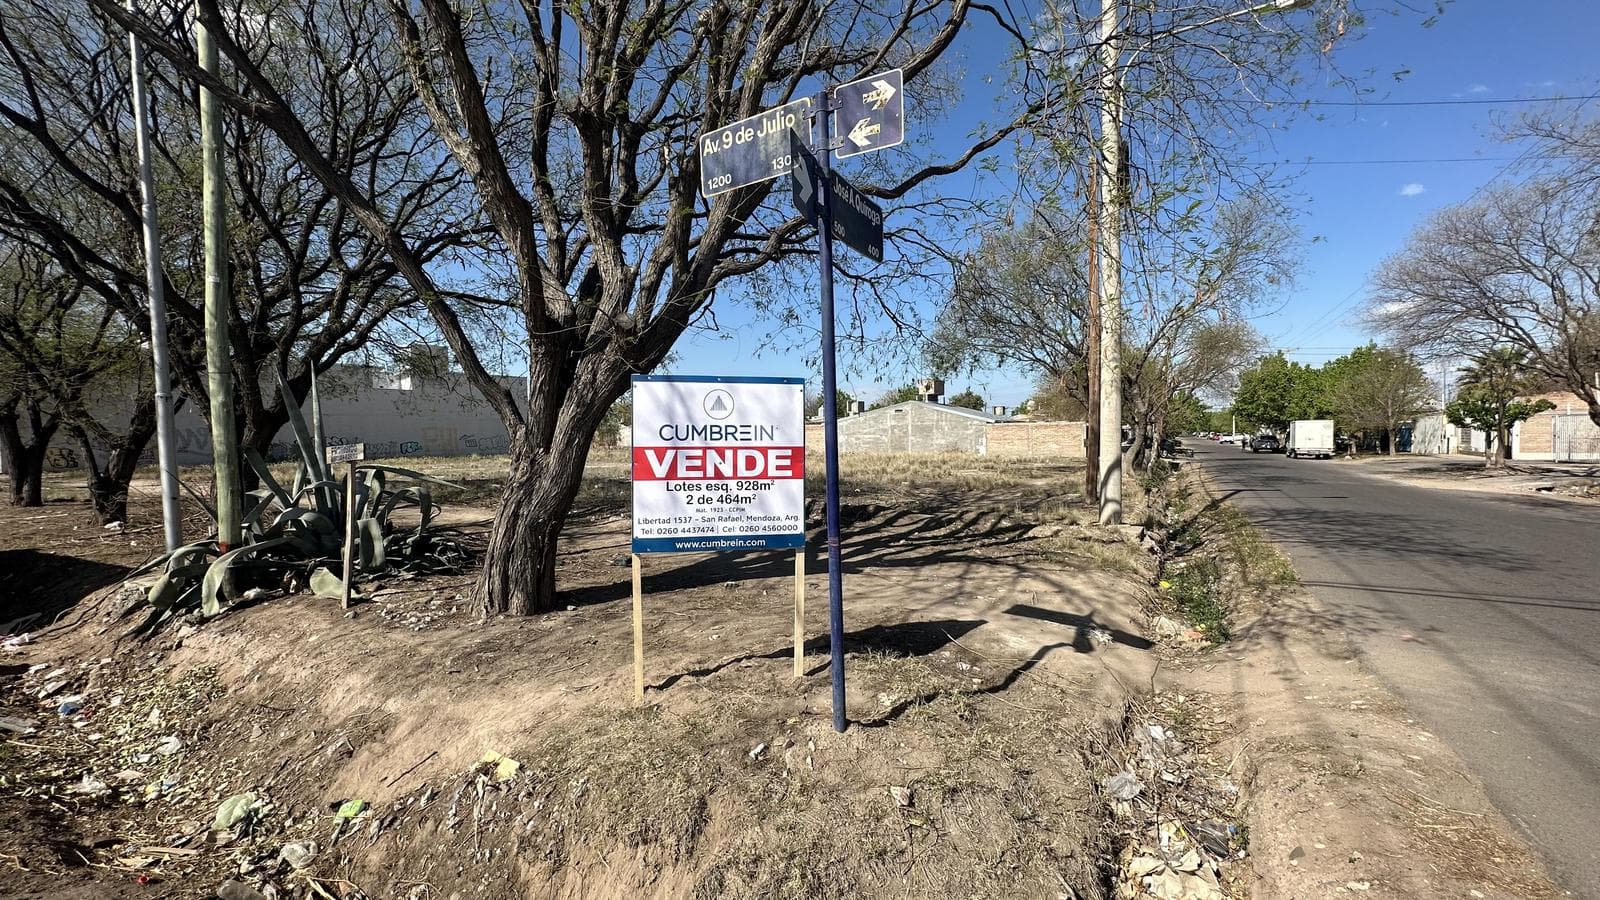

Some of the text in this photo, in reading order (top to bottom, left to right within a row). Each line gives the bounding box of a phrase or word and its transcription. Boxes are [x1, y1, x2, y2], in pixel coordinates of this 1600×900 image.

[703, 112, 795, 157] Av. 9 de Julio
[772, 155, 792, 170] 130
[708, 175, 732, 190] 1200
[834, 177, 849, 201] José
[855, 196, 880, 225] Quiroga
[834, 221, 846, 237] 500
[868, 244, 879, 258] 400
[659, 424, 774, 441] CUMBREIN
[644, 449, 792, 478] VENDE
[666, 480, 775, 494] Lotes esq. 928m²
[686, 494, 757, 504] 2 de 464m²
[675, 540, 765, 549] www.cumbrein.com
